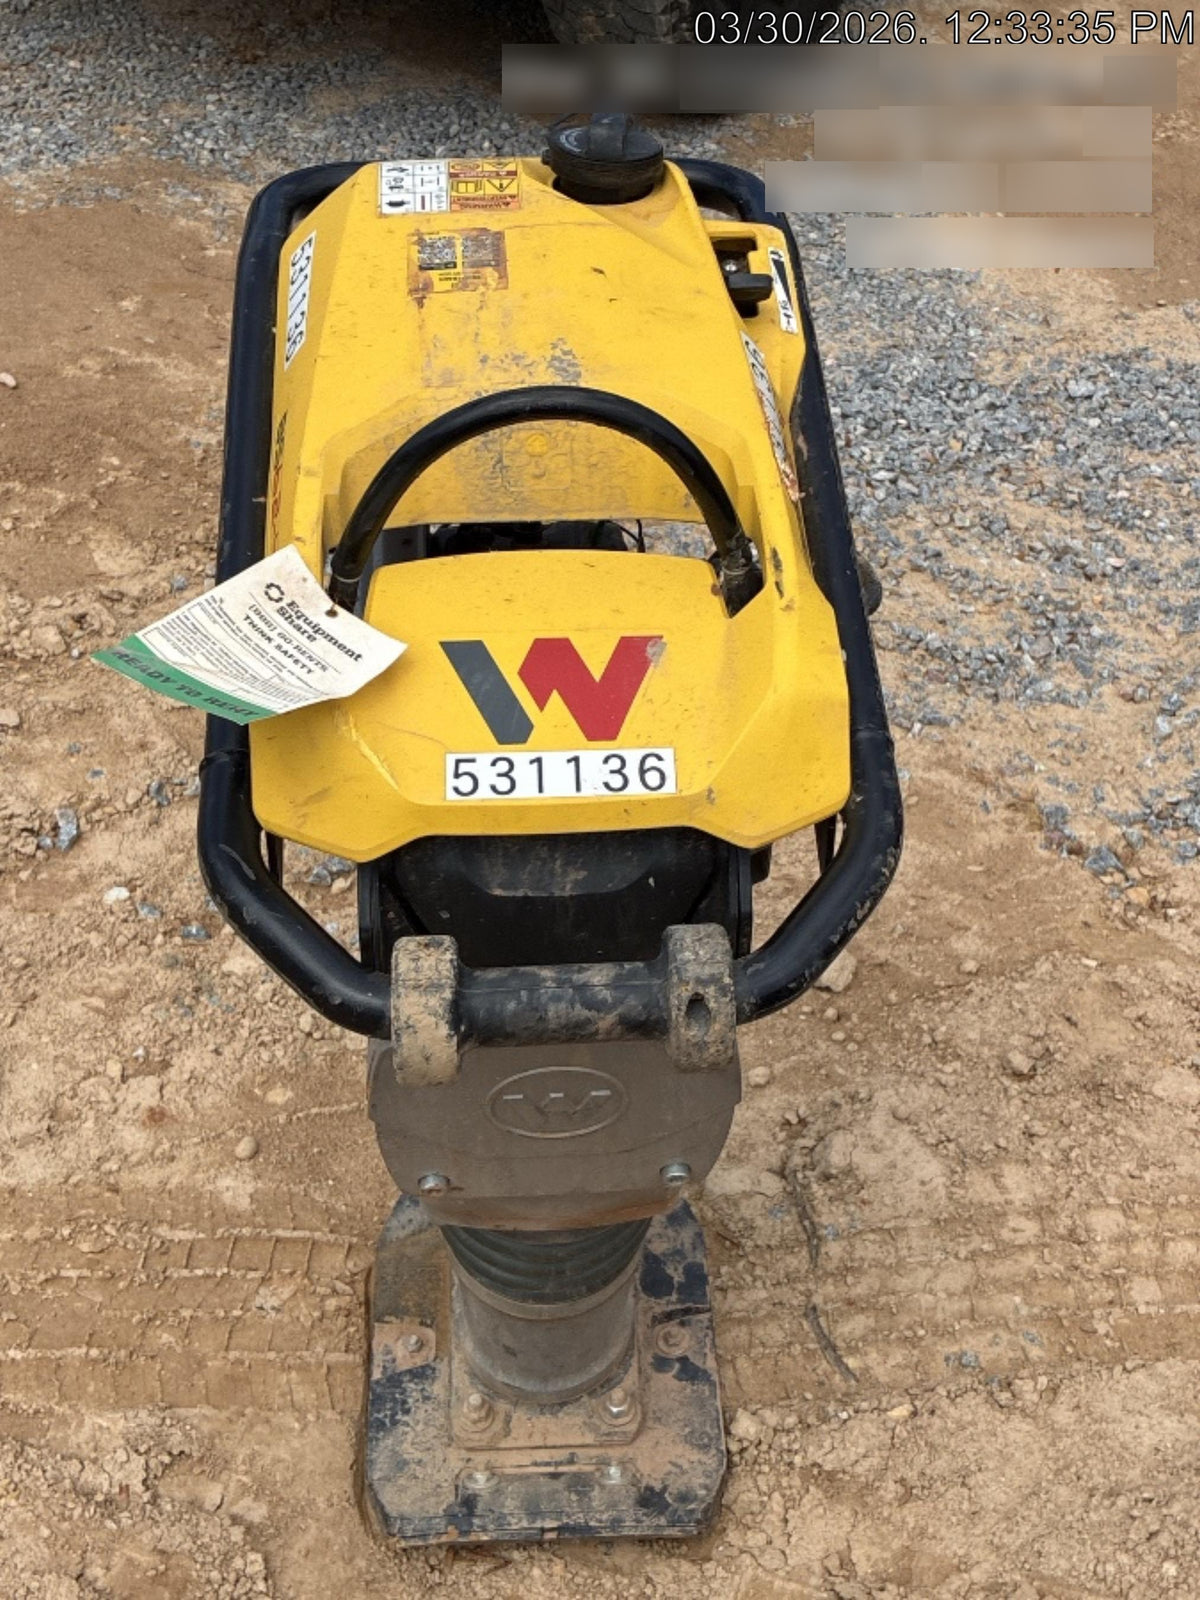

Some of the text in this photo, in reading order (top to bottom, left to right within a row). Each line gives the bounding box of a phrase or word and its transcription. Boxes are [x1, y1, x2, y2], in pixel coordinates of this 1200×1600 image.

[243, 614, 274, 644] THINK
[274, 642, 315, 675] SAFETY
[276, 605, 317, 643] Share
[286, 600, 363, 662] Equipment
[112, 650, 177, 684] READY
[175, 683, 203, 698] TO
[203, 696, 260, 716] RENT
[451, 752, 667, 797] 531136
